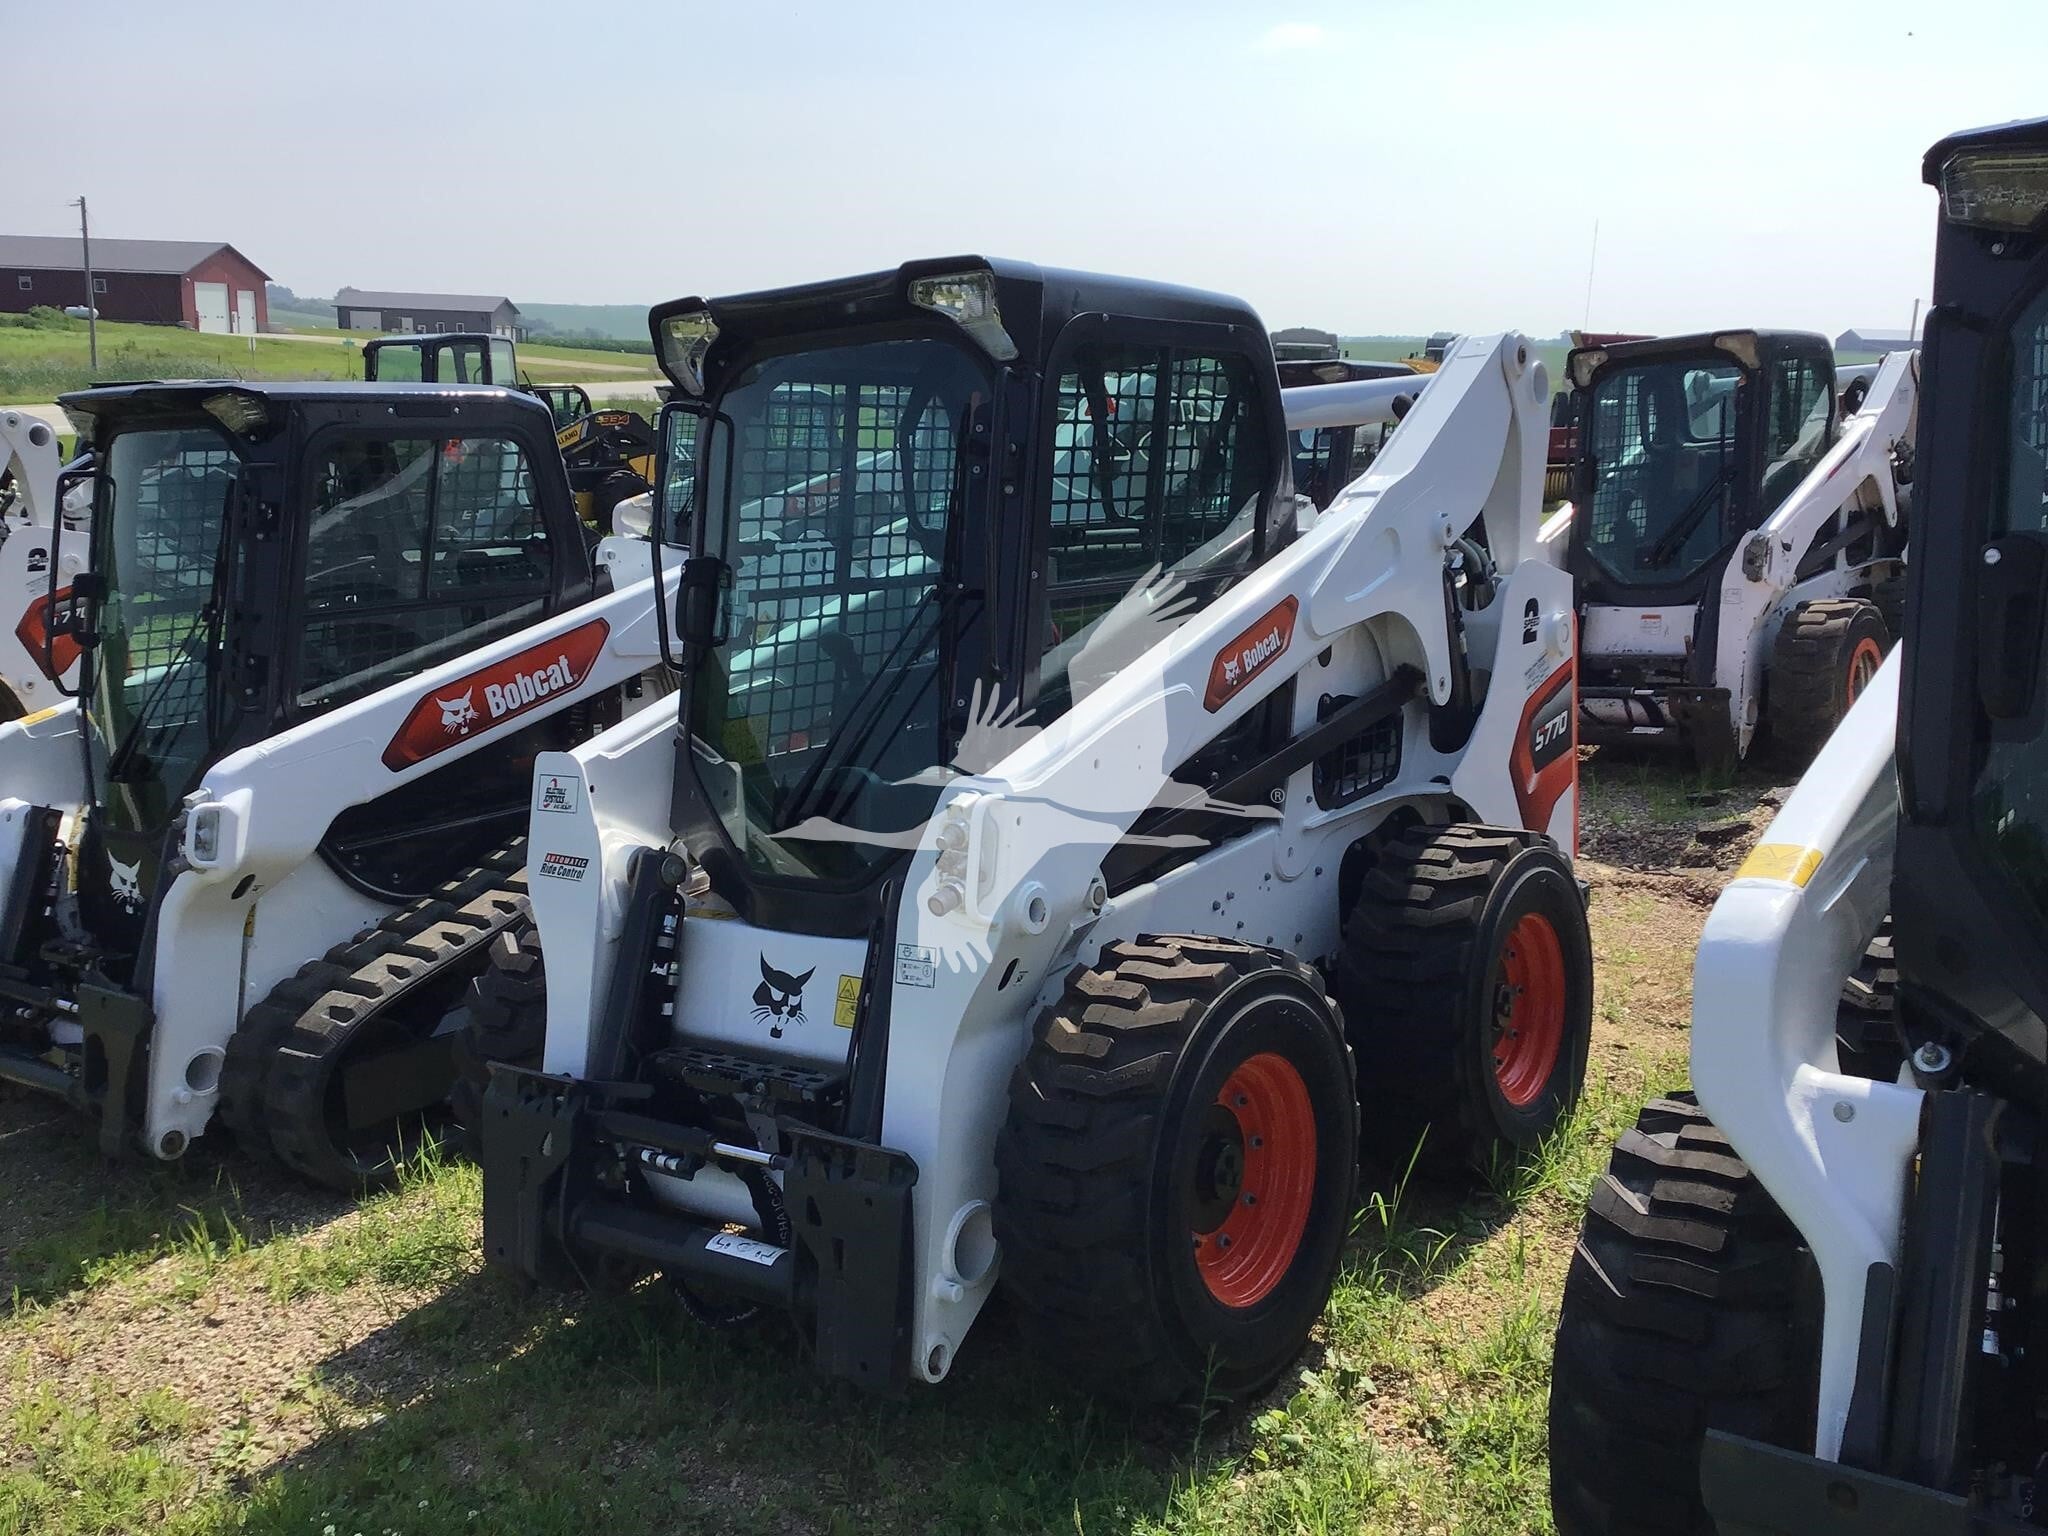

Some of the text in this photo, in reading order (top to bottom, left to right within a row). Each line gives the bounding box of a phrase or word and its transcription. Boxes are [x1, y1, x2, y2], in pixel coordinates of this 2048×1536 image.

[557, 429, 579, 445] LLAND
[1242, 626, 1281, 674] Bobcat
[484, 654, 573, 718] Bobcat
[1534, 710, 1569, 753] S770
[540, 863, 586, 880] Ride Control
[545, 854, 588, 867] AUTOMATIC
